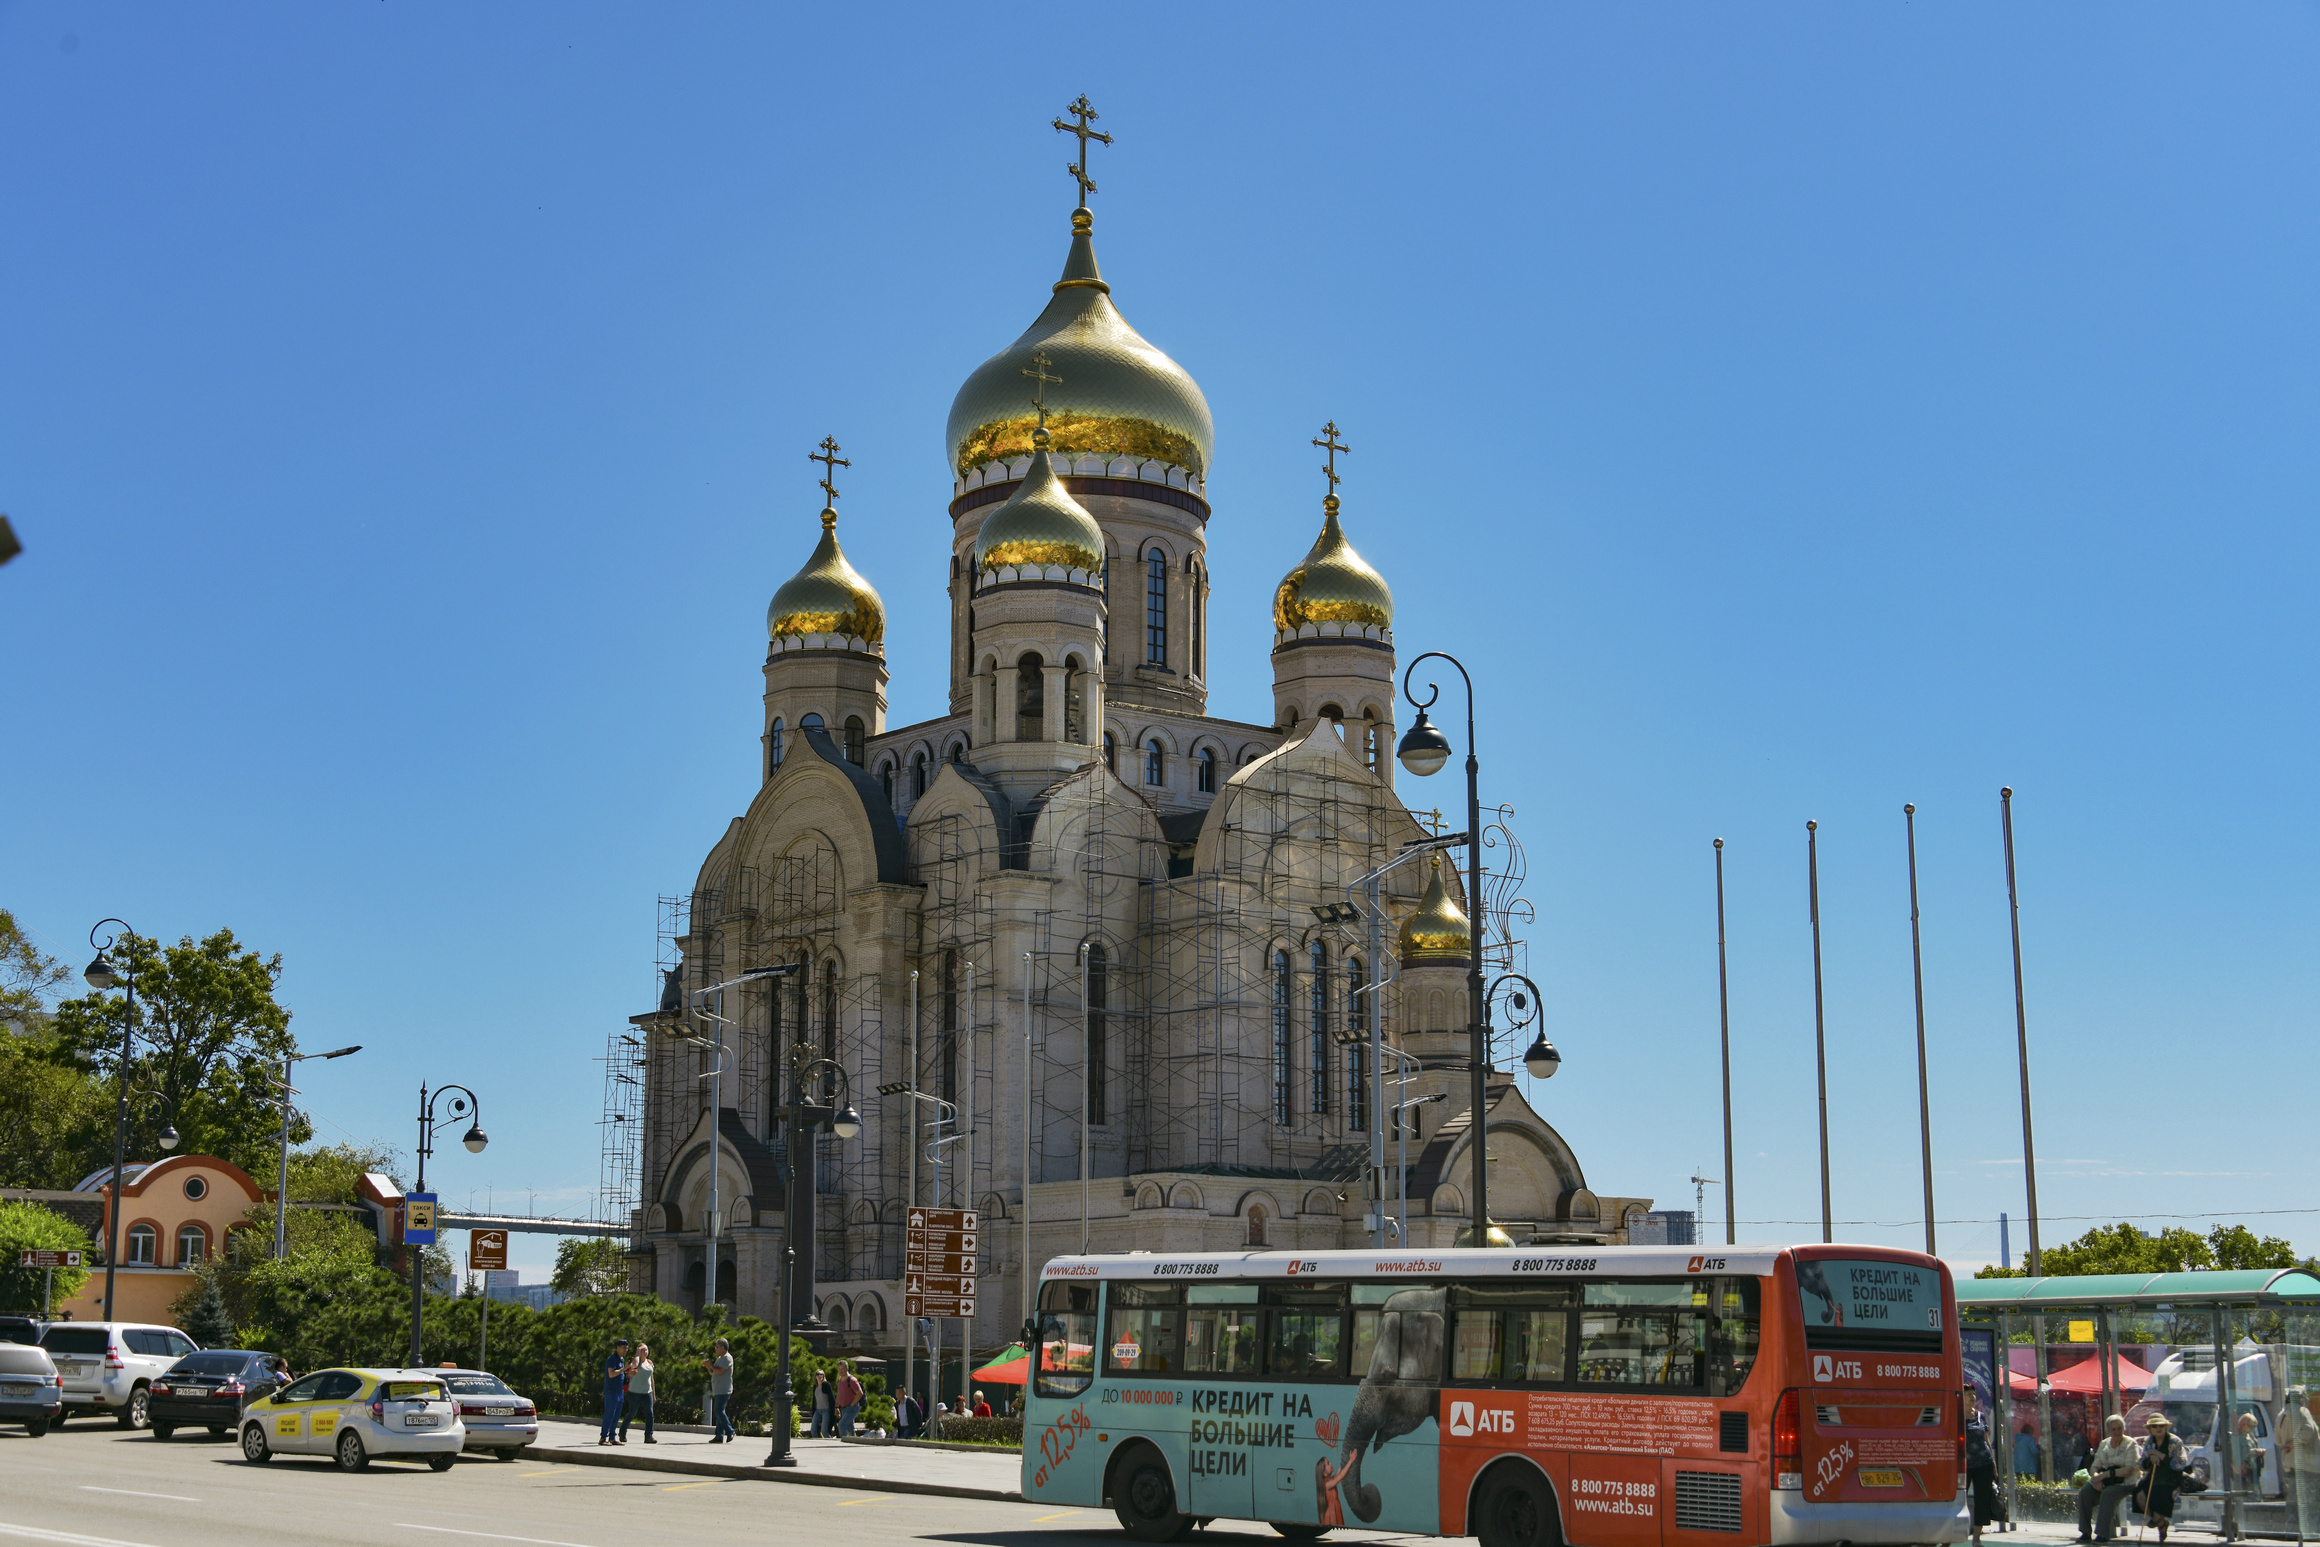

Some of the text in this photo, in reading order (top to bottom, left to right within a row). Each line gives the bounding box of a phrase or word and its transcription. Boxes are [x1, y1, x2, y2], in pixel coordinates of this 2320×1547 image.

[1046, 1264, 1099, 1276] www.atb.su
[1154, 1264, 1219, 1274] 8 800 775 8888
[1299, 1262, 1317, 1272] АТБ
[1375, 1258, 1442, 1272] www.atb.su
[1512, 1259, 1597, 1271] 8 800 775 8888
[1704, 1258, 1726, 1270] АТБ
[1850, 1268, 1921, 1286] КРЕДИТ НА
[1852, 1286, 1913, 1302] БОЛЬШИЕ
[1854, 1303, 1889, 1320] ЦЕЛИ
[1928, 1309, 1940, 1327] 31
[1835, 1361, 1862, 1379] АТБ
[1877, 1365, 1940, 1378] 8 800 775 8888
[1102, 1389, 1118, 1405] ДО
[1121, 1390, 1131, 1404] 10
[1134, 1390, 1152, 1404] 000
[1154, 1390, 1173, 1405] 000
[1192, 1390, 1313, 1418] КРЕДИТ НА
[1478, 1409, 1514, 1433] АТБ
[1192, 1420, 1294, 1448] БОЛЬШИЕ
[1035, 1402, 1090, 1488] от 12,5%
[1191, 1450, 1246, 1477] ЦЕЛИ
[1813, 1440, 1854, 1496] от 12,5%
[1572, 1479, 1656, 1497] 8 800 775 8888
[1575, 1497, 1654, 1516] www.atb.su
